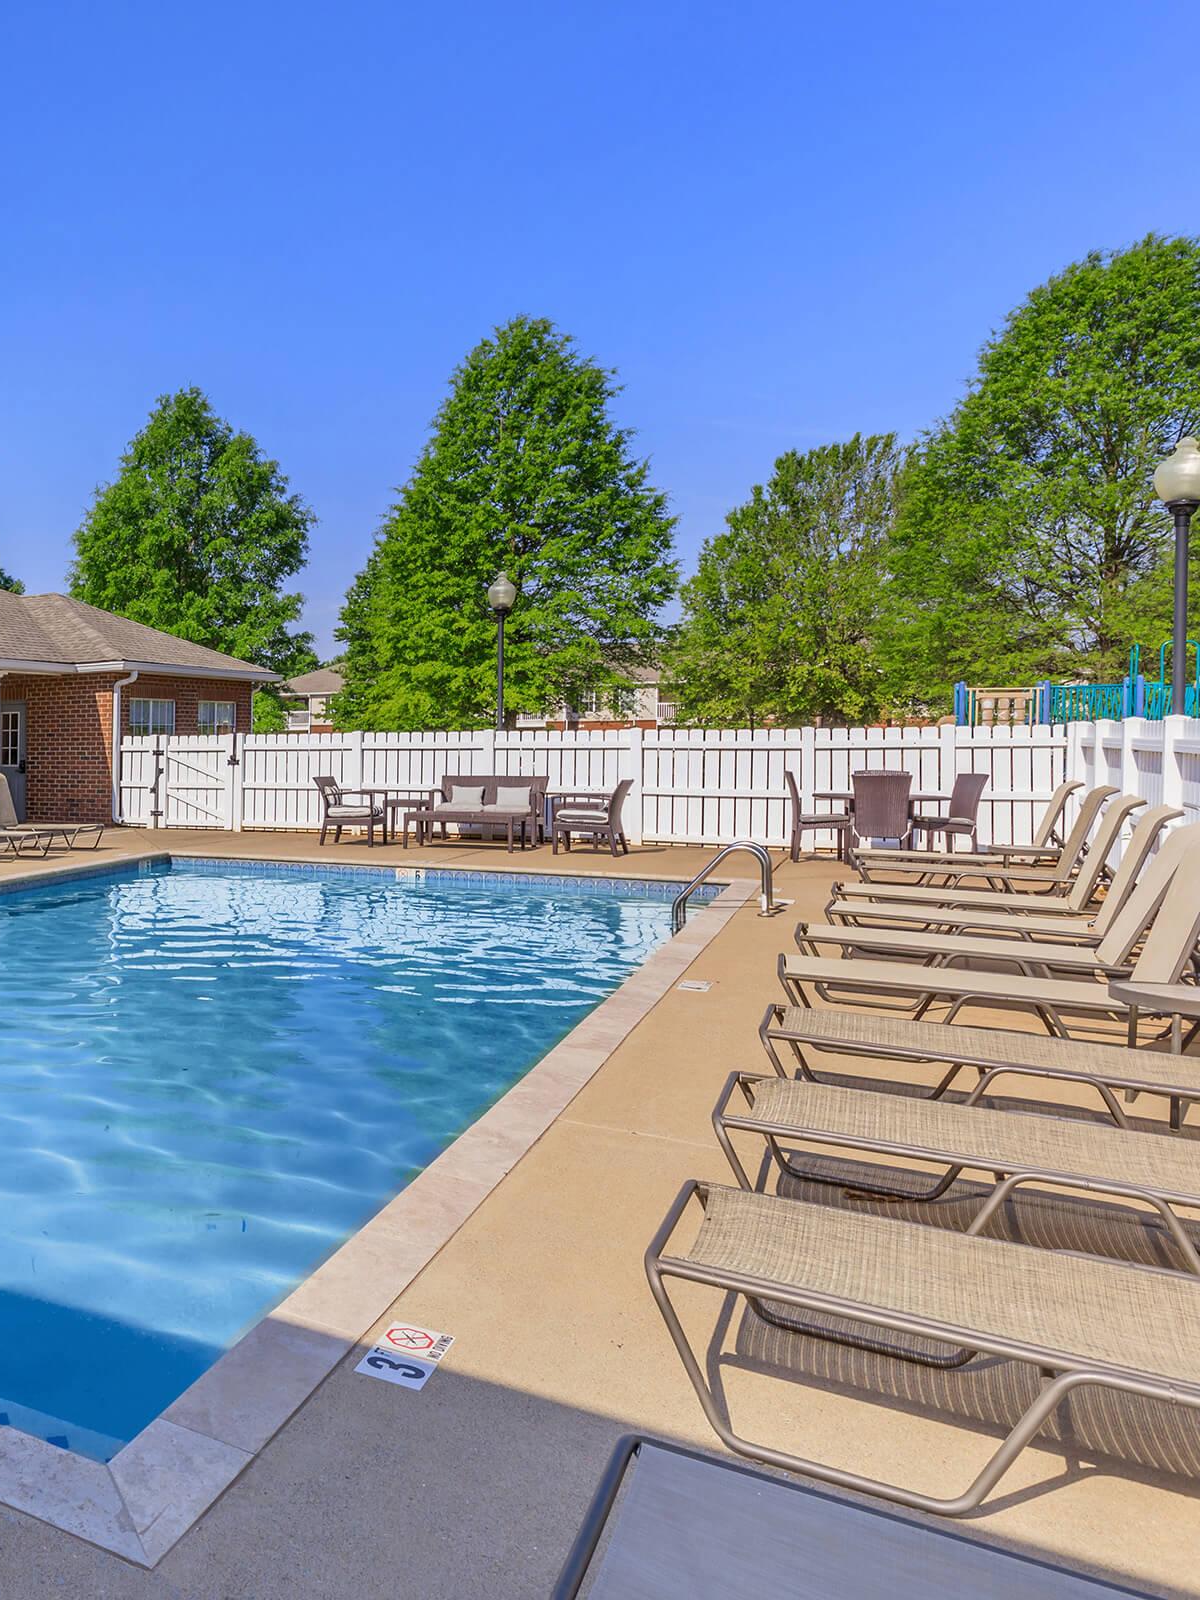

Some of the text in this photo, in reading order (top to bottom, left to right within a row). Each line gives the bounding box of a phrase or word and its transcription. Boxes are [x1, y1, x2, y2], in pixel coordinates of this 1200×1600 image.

[426, 1335, 453, 1360] NO DIVING
[366, 1355, 426, 1380] 3
